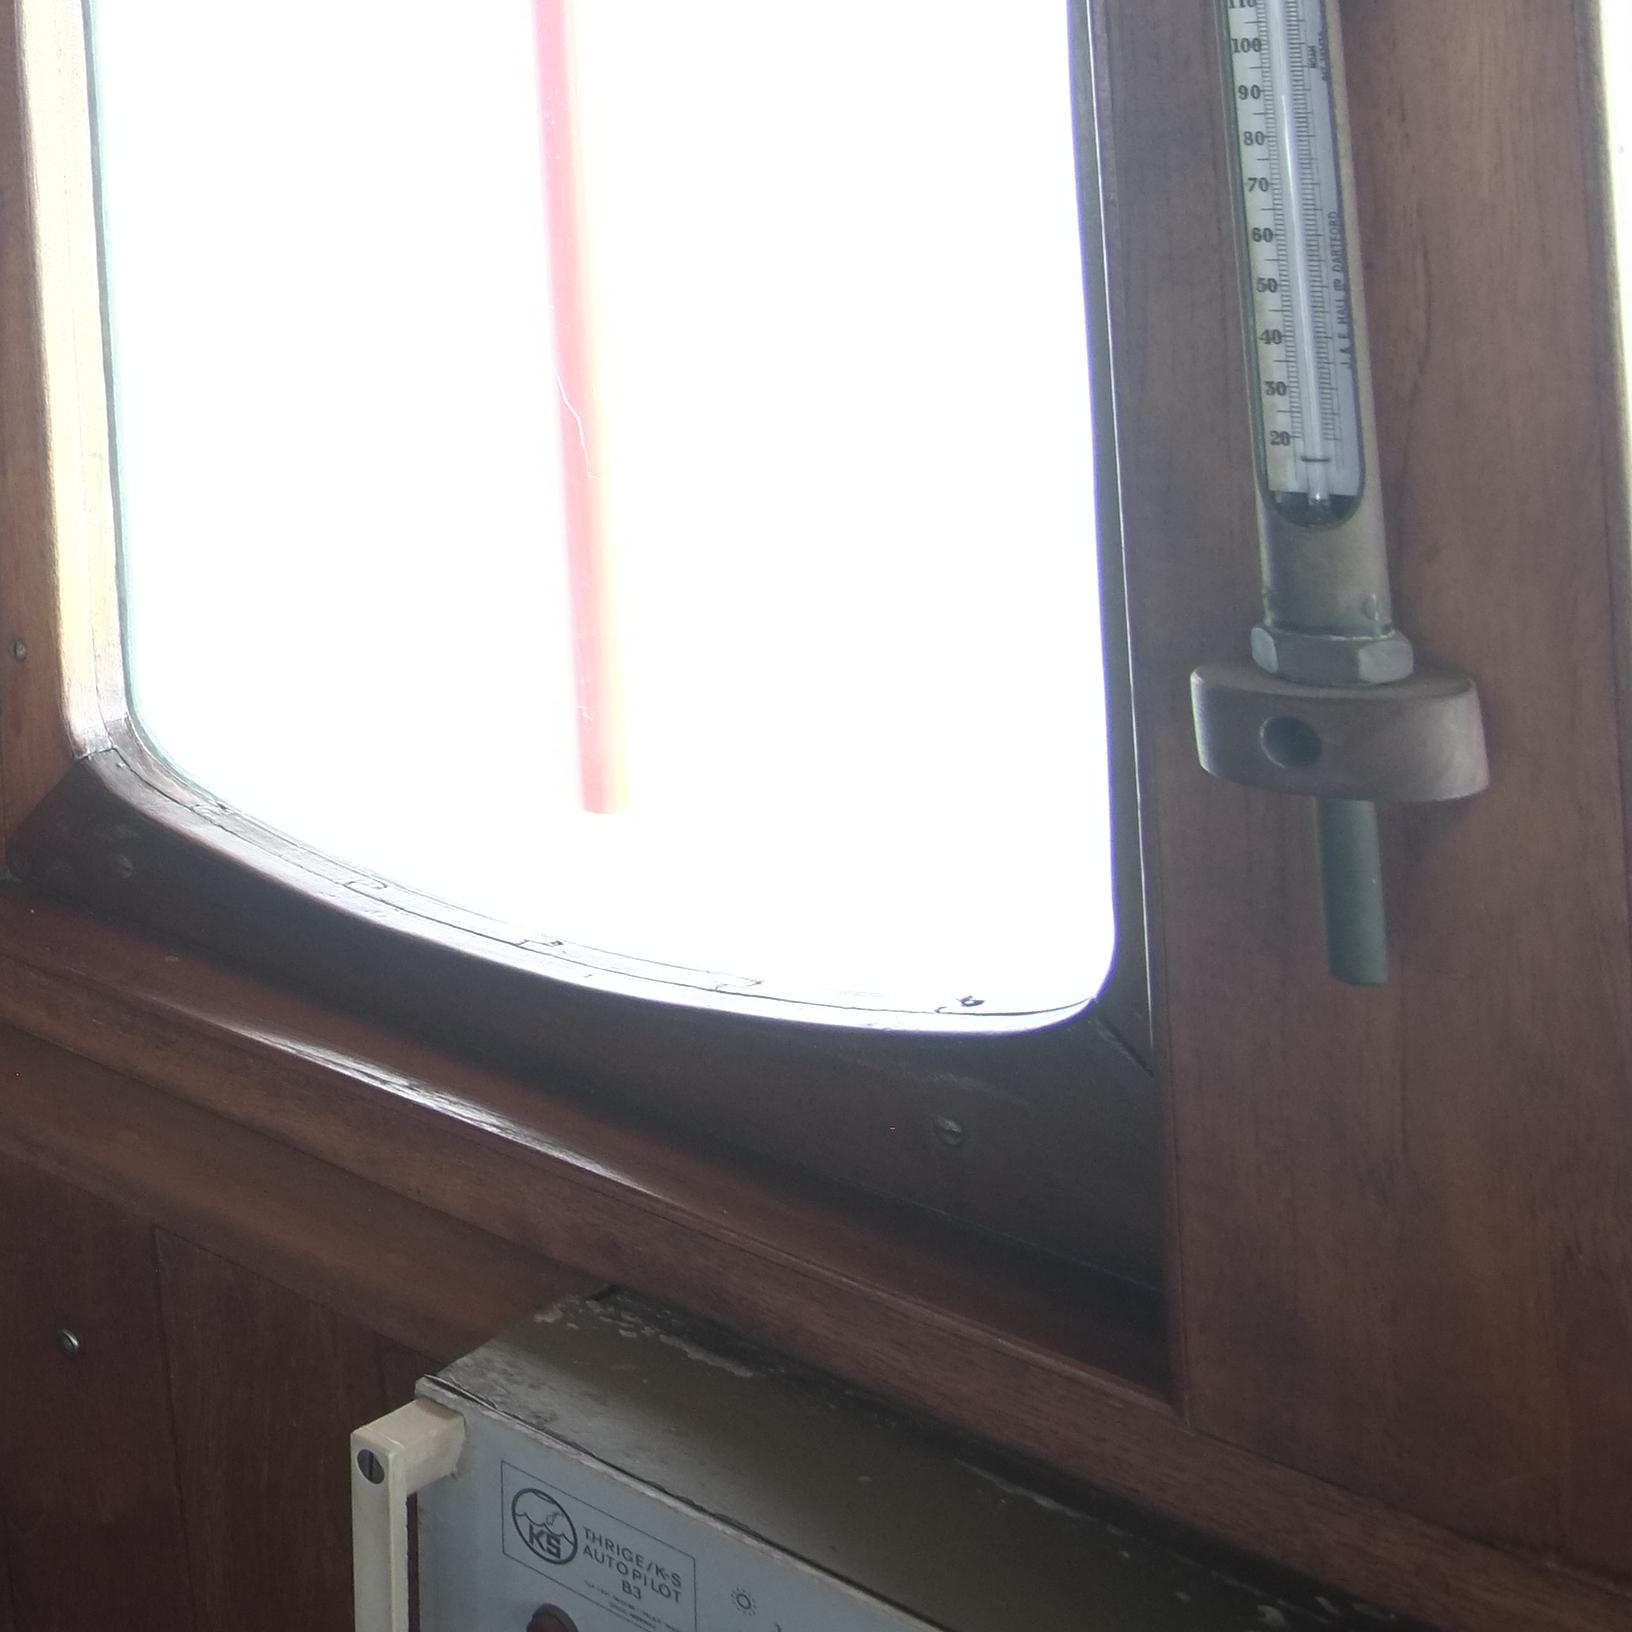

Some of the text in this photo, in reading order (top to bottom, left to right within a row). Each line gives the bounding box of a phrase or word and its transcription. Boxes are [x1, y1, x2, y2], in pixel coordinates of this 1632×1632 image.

[1231, 37, 1263, 54] 100
[1238, 84, 1262, 101] 90
[1243, 130, 1265, 146] 80
[1247, 177, 1271, 193] 70
[1252, 227, 1274, 243] 60
[1328, 210, 1346, 273] DARTFORD
[1256, 277, 1279, 293] 50
[1260, 328, 1283, 345] 40
[1264, 380, 1288, 397] 30
[1270, 430, 1291, 447] 20
[528, 1523, 561, 1560] KS
[621, 1579, 642, 1600] B3
